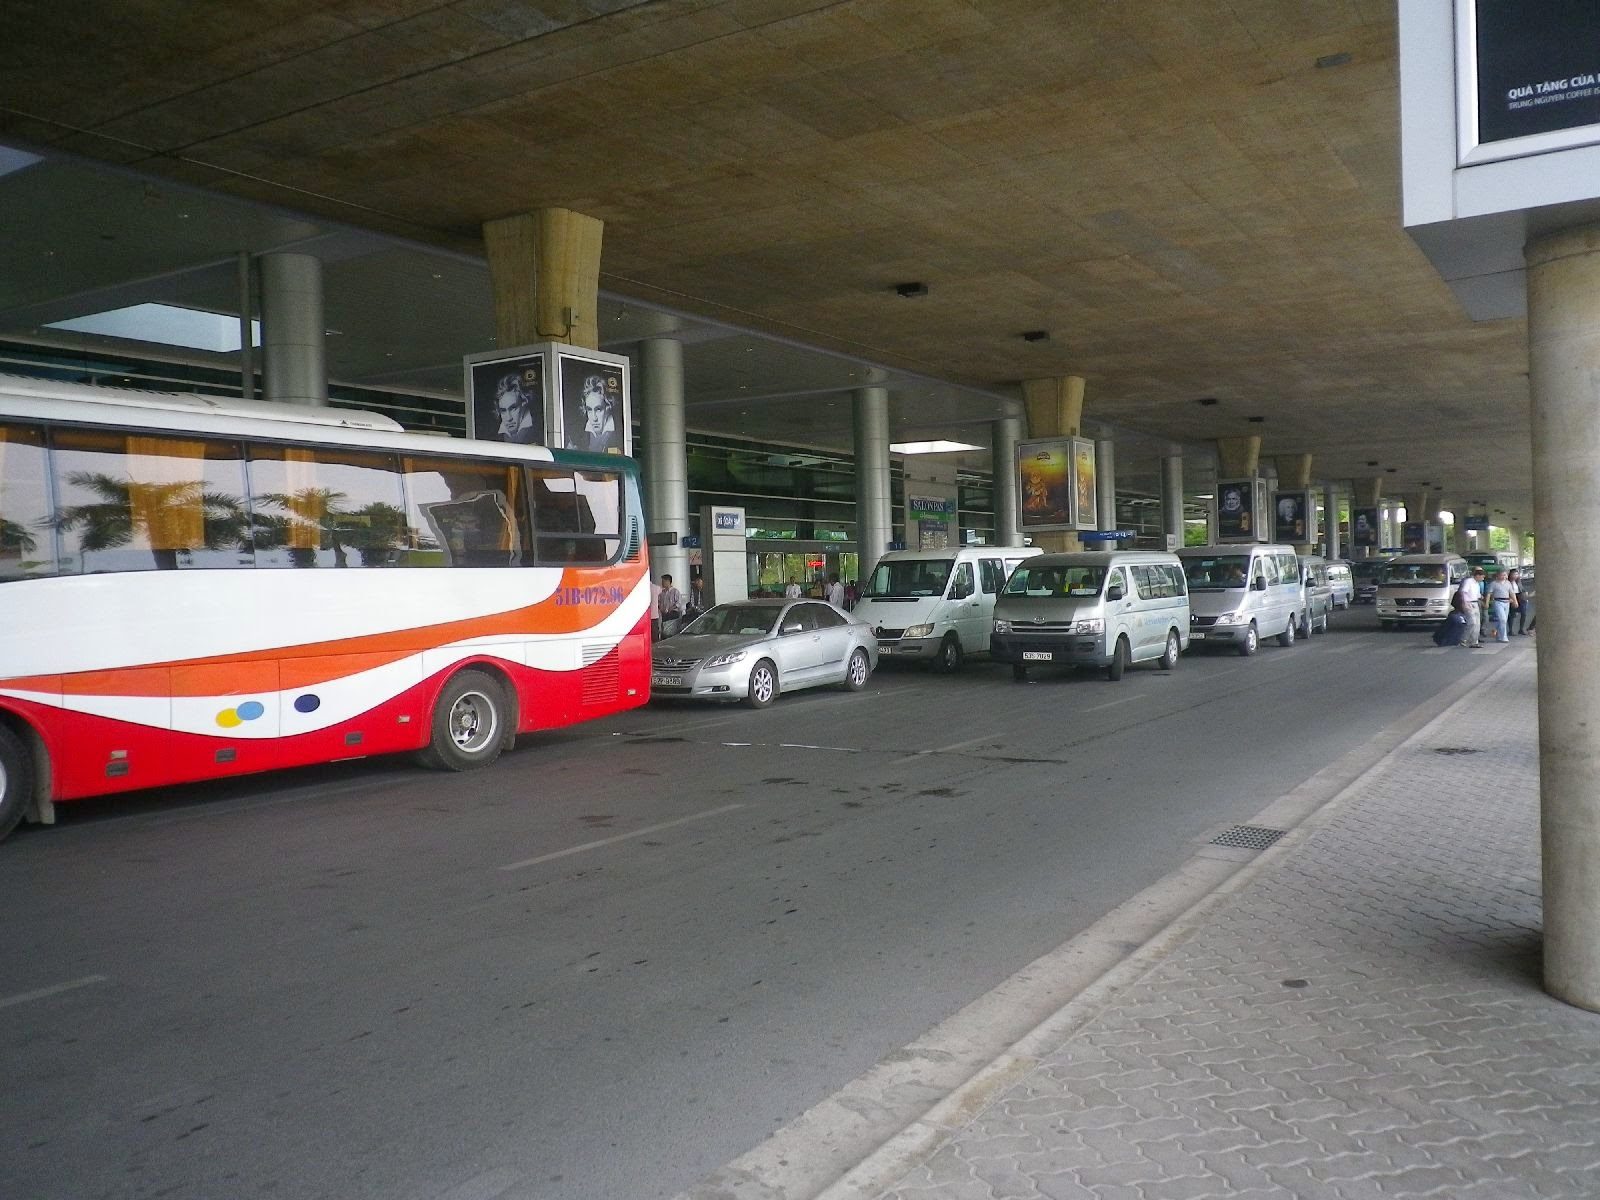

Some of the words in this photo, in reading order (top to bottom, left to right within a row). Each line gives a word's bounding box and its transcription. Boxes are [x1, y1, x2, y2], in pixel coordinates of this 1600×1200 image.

[1570, 74, 1595, 87] CỦA
[1566, 88, 1591, 99] COFFEE
[913, 500, 944, 511] SALONPAS
